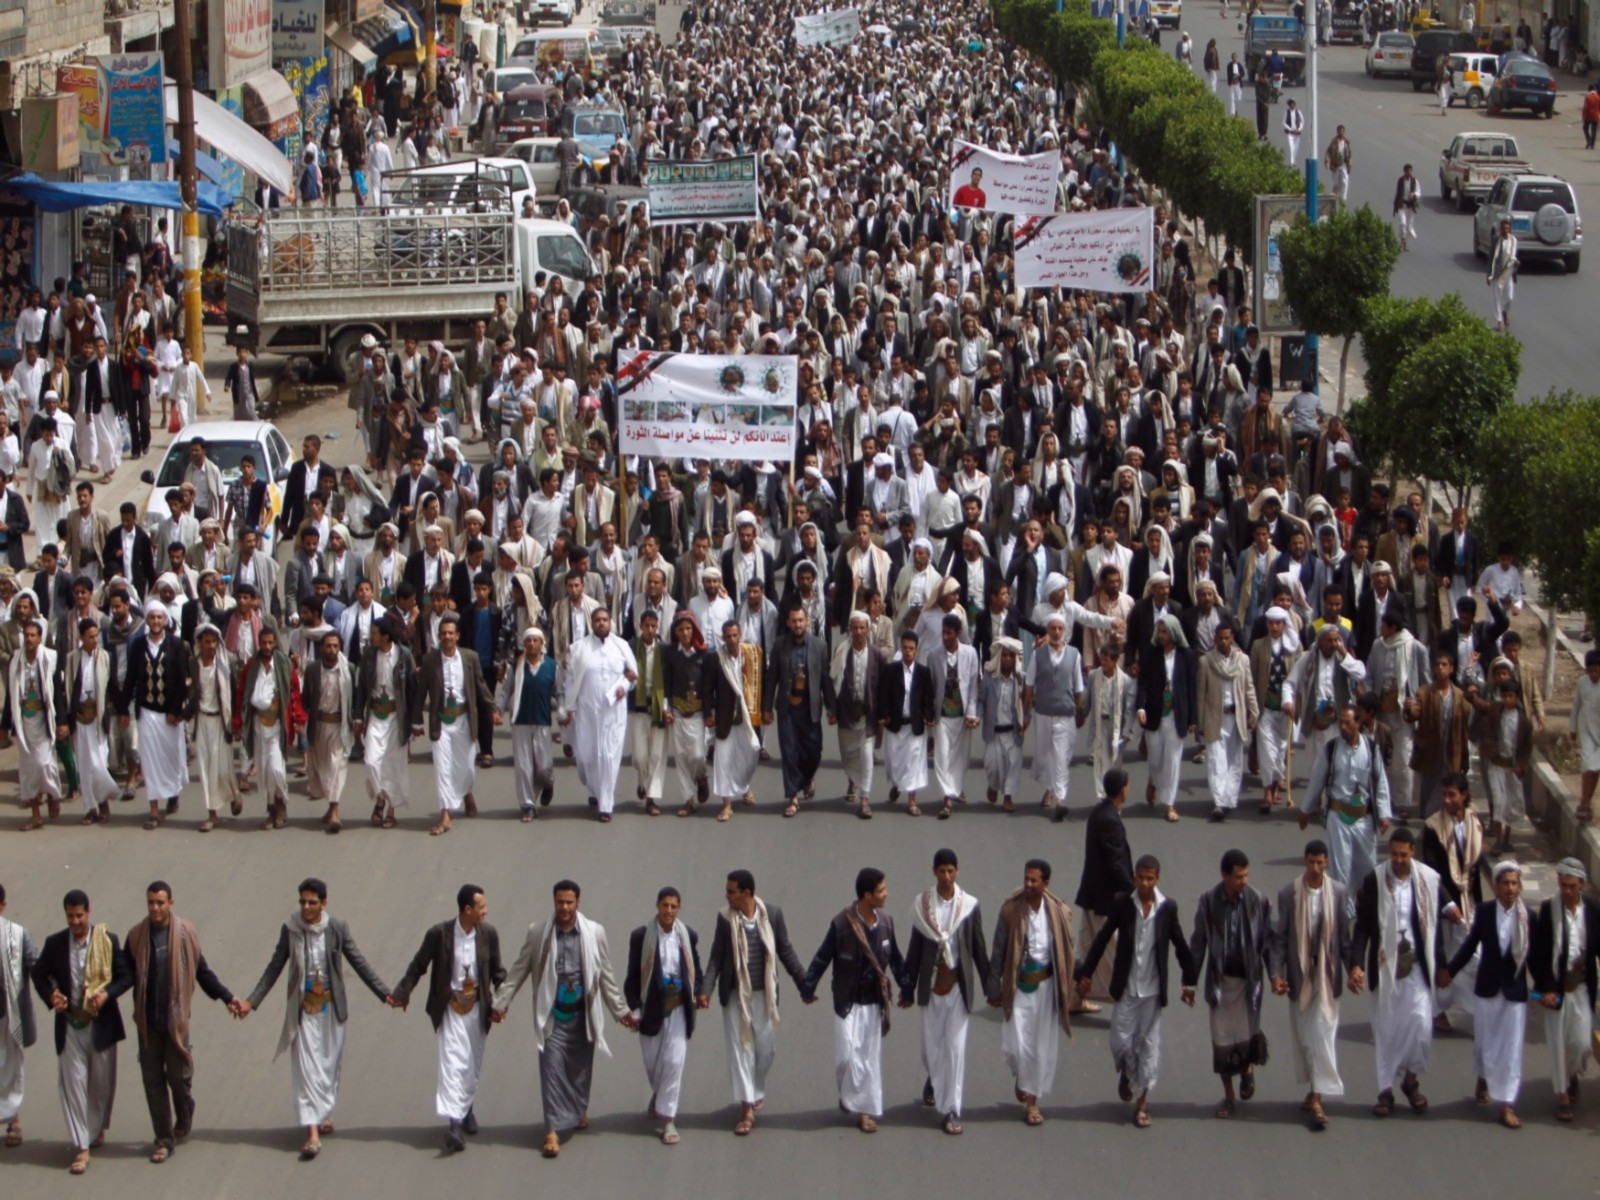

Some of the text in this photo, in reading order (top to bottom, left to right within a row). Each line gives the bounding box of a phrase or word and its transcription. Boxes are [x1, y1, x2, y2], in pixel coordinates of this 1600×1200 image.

[626, 424, 650, 440] الثورة
[653, 426, 684, 442] مواصلة
[687, 428, 701, 443] عن
[729, 430, 741, 445] لن
